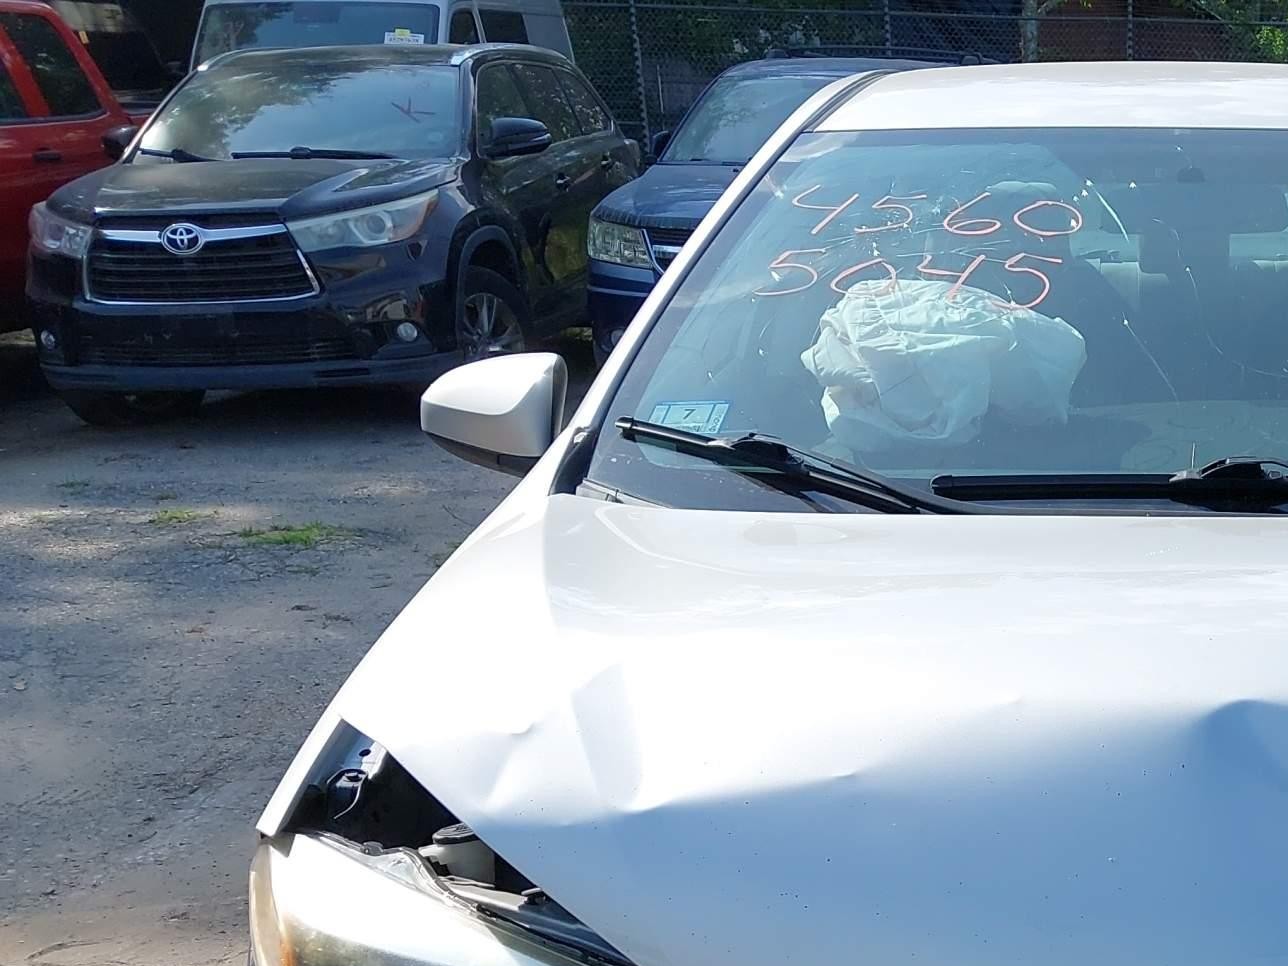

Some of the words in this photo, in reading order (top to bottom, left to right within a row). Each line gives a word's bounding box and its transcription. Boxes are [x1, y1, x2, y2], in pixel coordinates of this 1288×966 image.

[792, 185, 1083, 236] 4560
[753, 247, 1063, 310] 5045
[683, 408, 697, 420] 7
